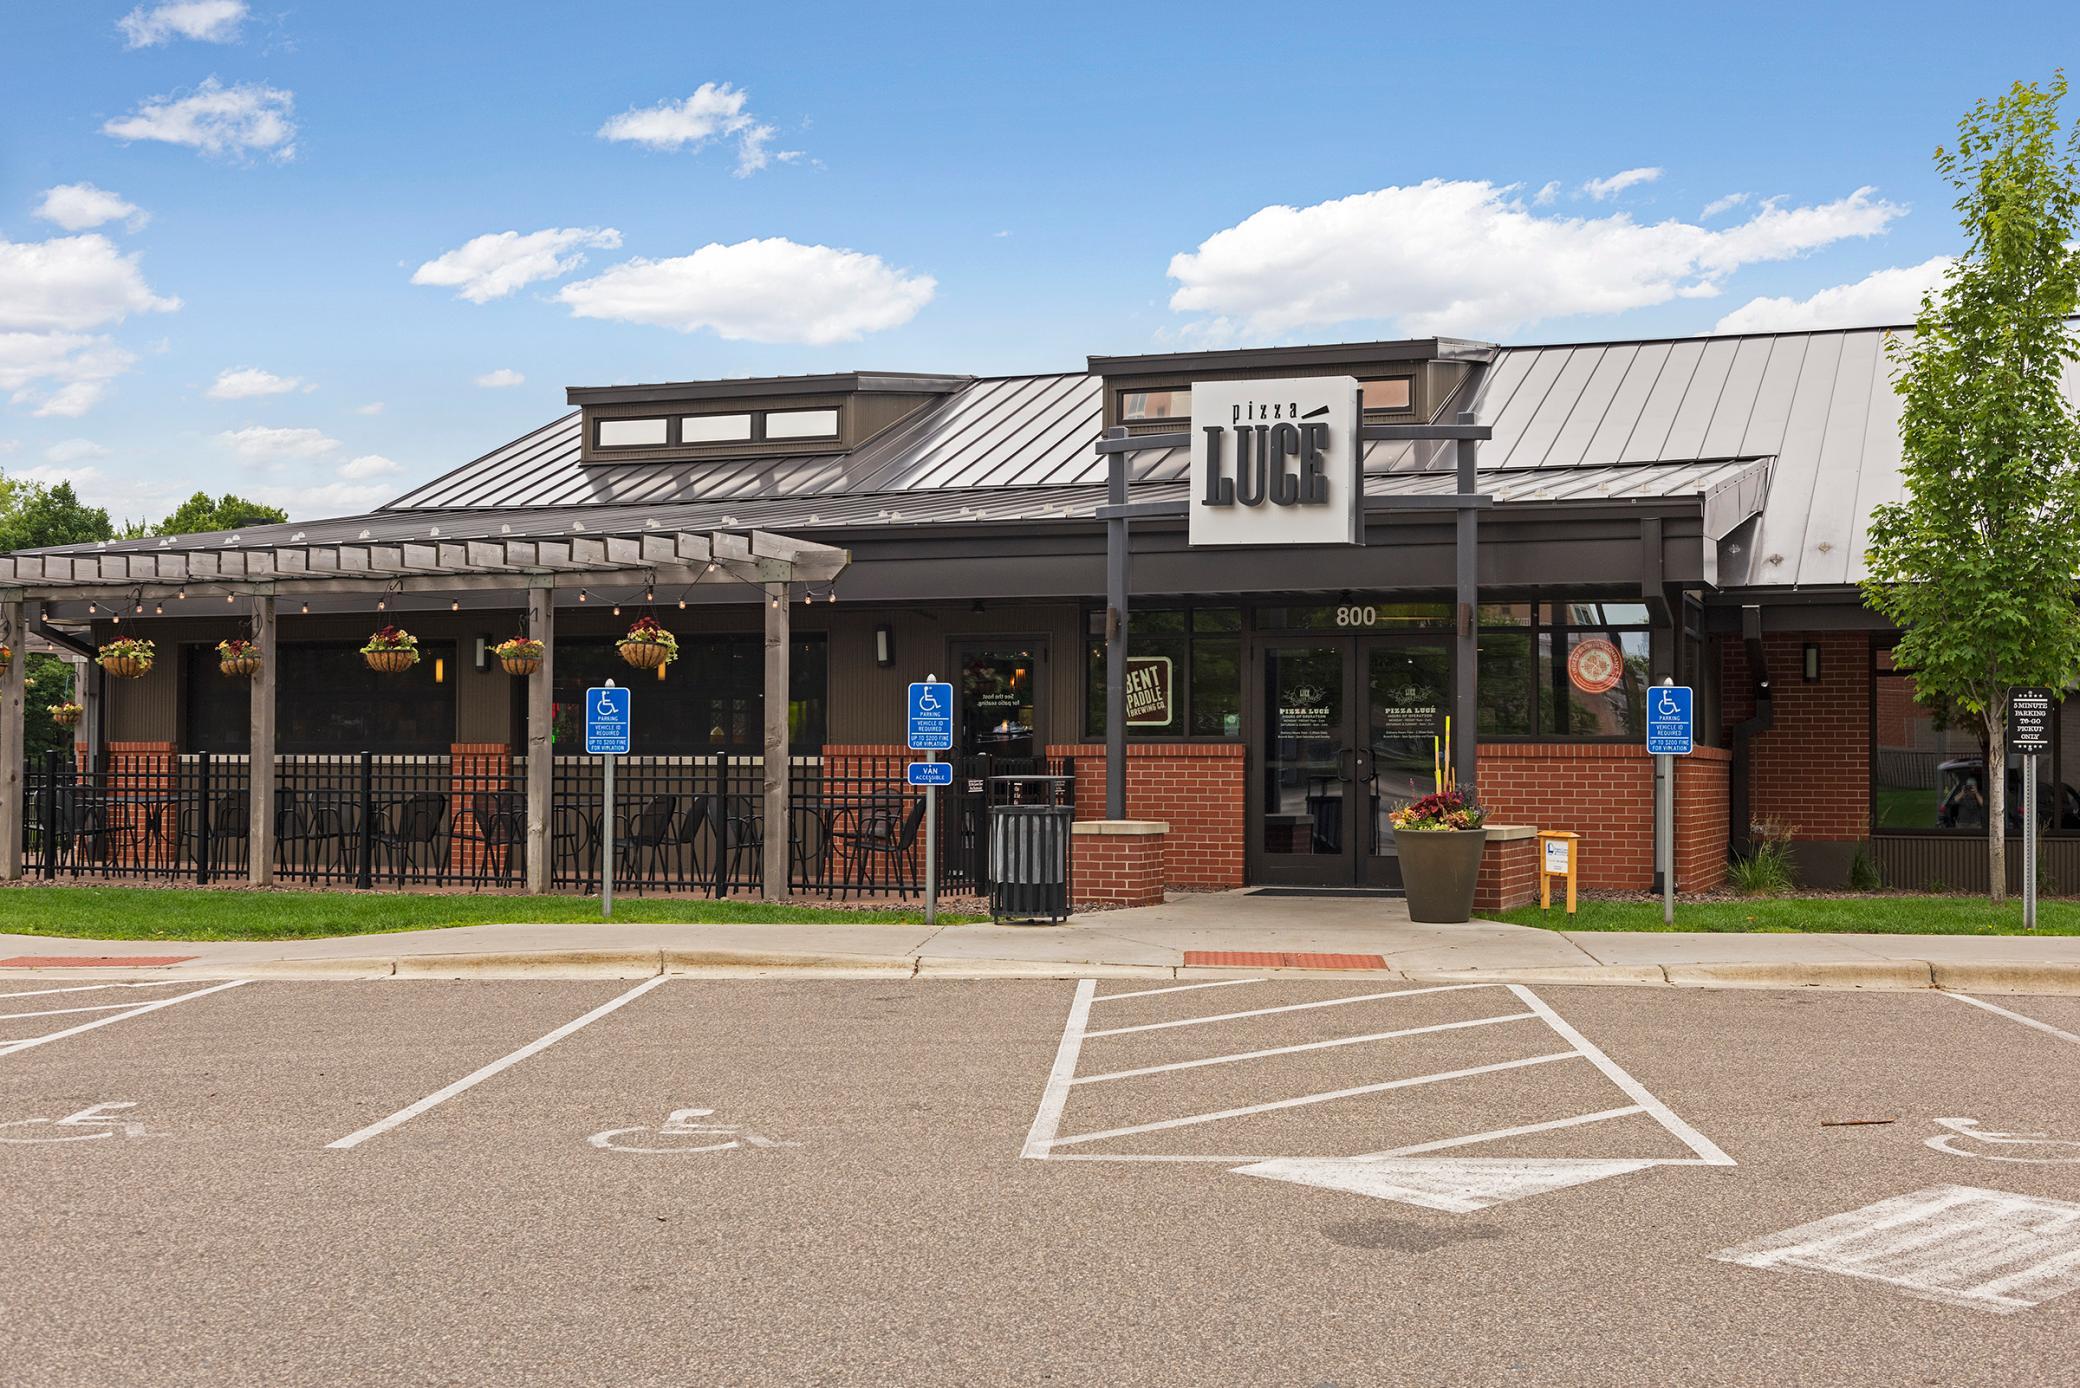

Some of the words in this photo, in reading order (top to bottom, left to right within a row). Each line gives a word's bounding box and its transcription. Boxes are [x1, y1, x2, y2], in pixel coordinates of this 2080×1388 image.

[1233, 401, 1297, 424] pizza
[1202, 405, 1329, 506] LUCÉ
[1337, 606, 1376, 626] 800
[1127, 665, 1159, 694] BENT
[1128, 686, 1162, 709] PADDLE
[1130, 704, 1156, 717] BREWING
[1308, 706, 1329, 714] LUCÉ
[1415, 705, 1436, 714] LUCÉ
